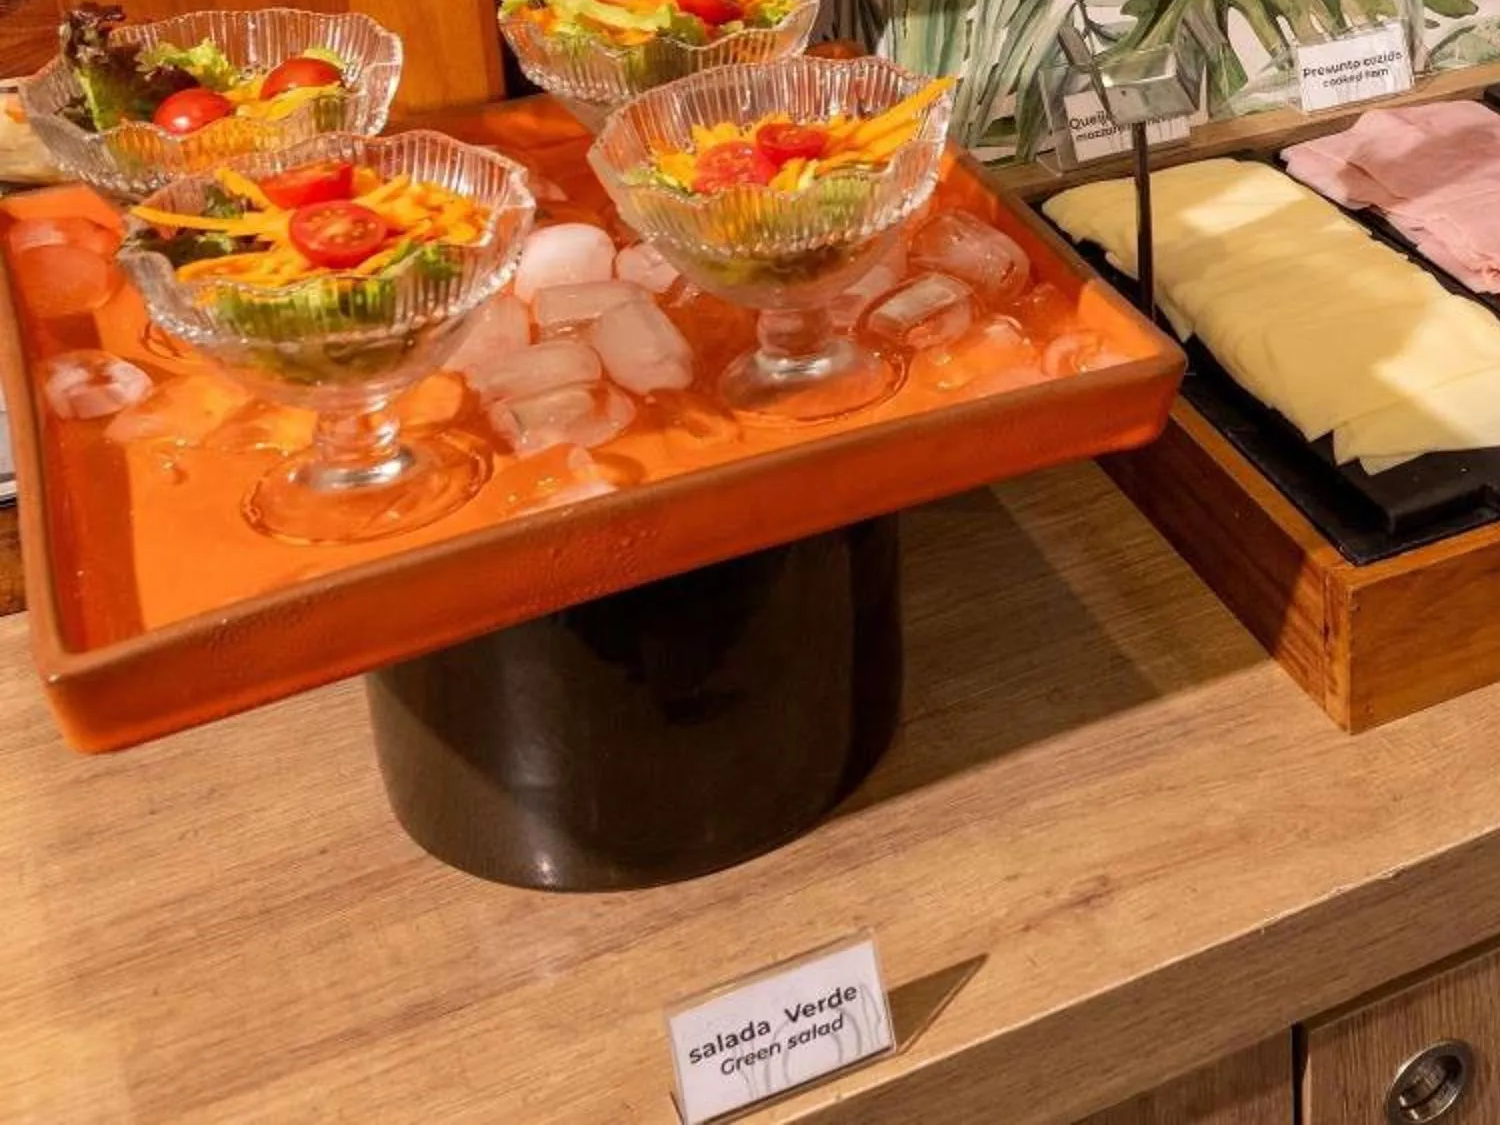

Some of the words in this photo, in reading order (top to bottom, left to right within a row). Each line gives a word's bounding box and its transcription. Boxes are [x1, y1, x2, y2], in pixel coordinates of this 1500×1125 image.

[1069, 110, 1107, 129] Queij
[688, 1020, 772, 1065] salada
[784, 985, 858, 1024] Verde
[720, 1041, 781, 1076] Green
[787, 1014, 845, 1051] salad
